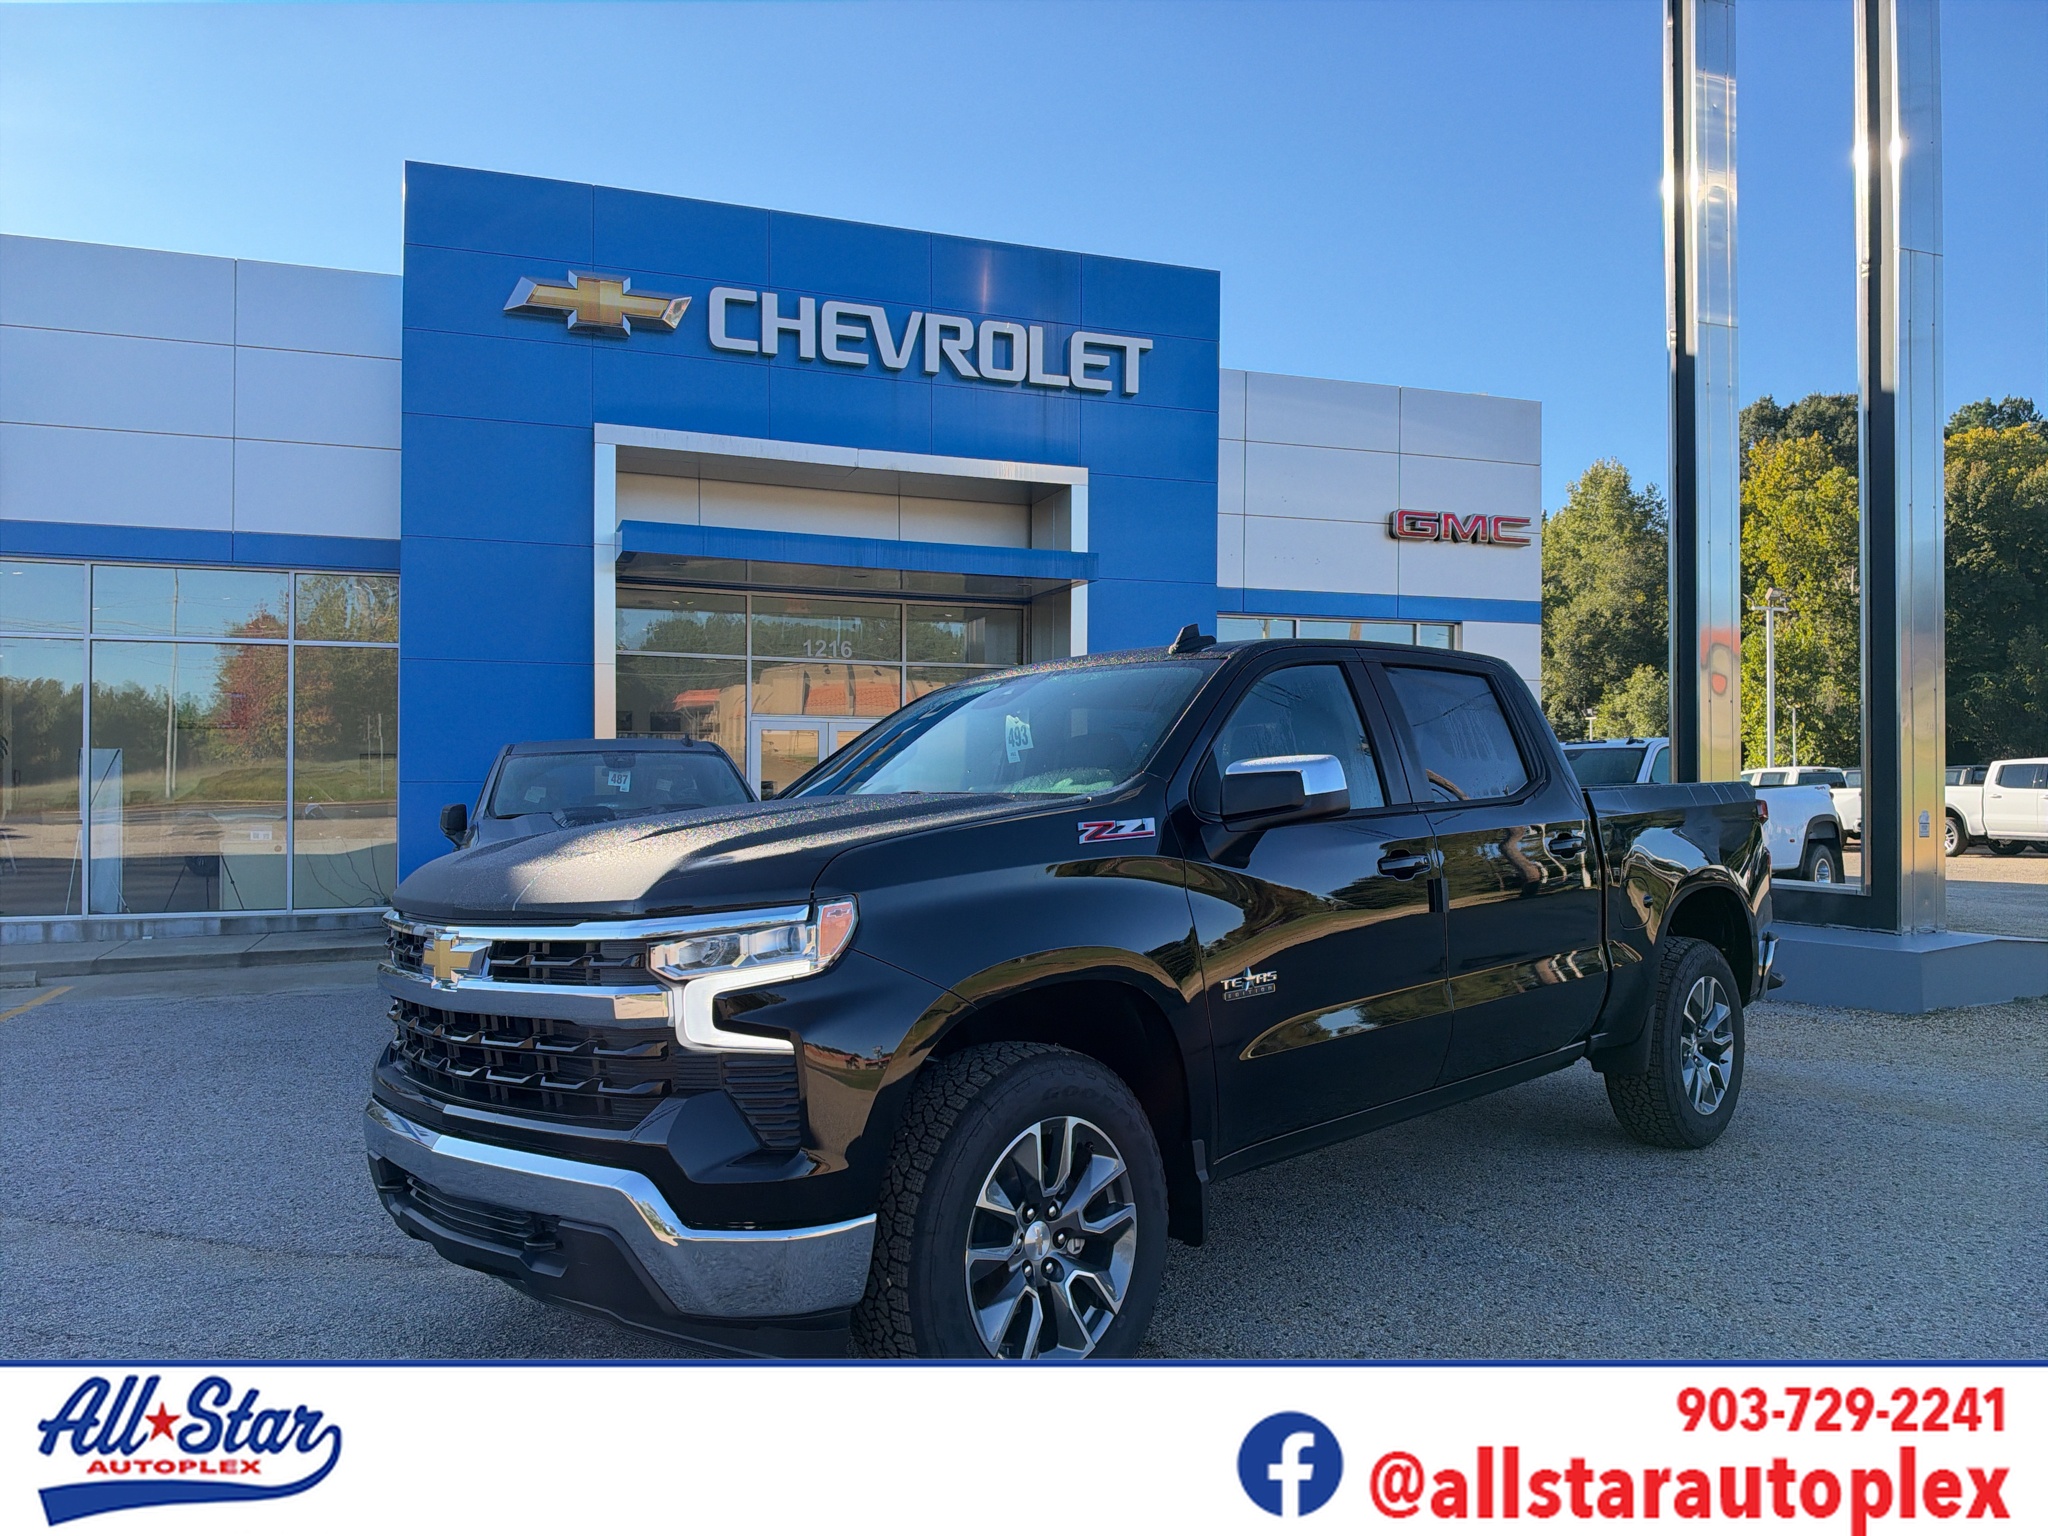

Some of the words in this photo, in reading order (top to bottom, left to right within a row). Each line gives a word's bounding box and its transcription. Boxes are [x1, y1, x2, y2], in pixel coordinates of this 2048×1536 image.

[708, 285, 1154, 397] CHEVROLET
[1391, 508, 1532, 547] GMC
[803, 638, 853, 659] 1216
[1008, 724, 1029, 748] 493
[610, 772, 629, 786] 487
[1077, 817, 1156, 845] Z71
